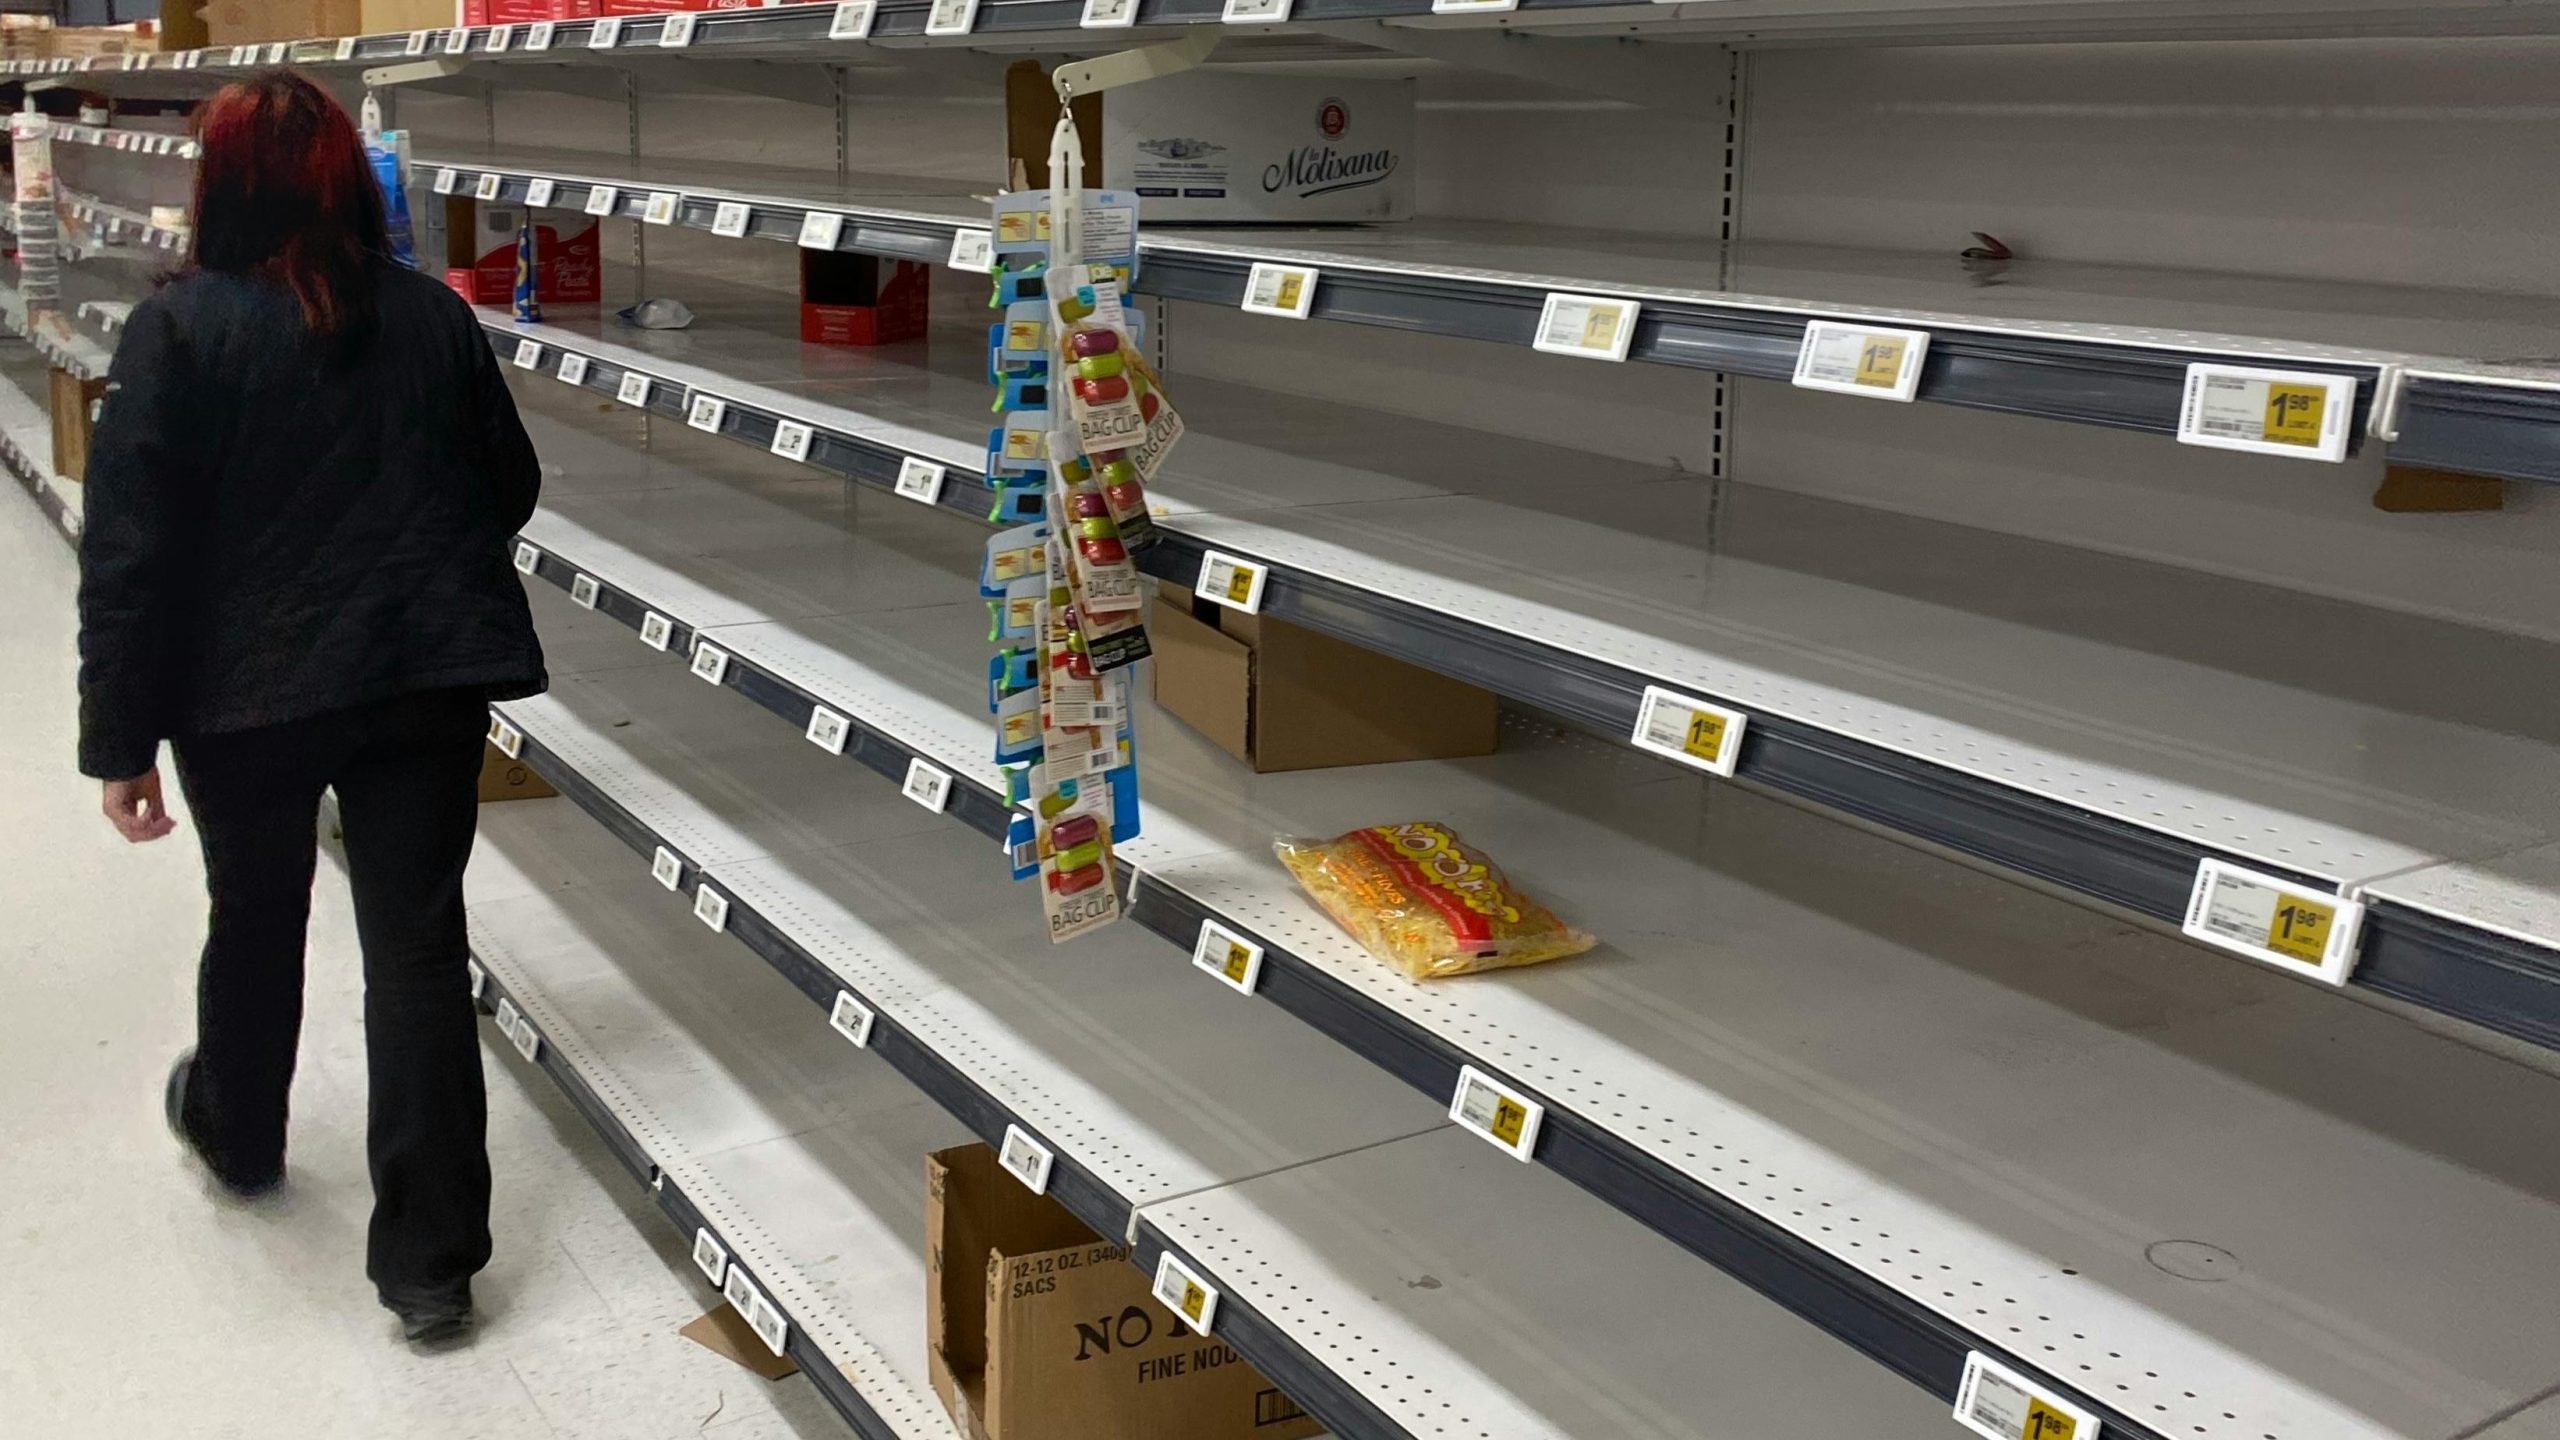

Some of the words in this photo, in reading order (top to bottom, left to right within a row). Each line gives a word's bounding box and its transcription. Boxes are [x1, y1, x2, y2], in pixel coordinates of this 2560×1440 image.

[1262, 145, 1397, 193] Molisana
[1081, 419, 1112, 440] BAG
[1112, 413, 1141, 434] CLIP
[1134, 438, 1160, 471] BAG
[1155, 411, 1176, 442] CLIP
[1086, 580, 1114, 598] BAG
[1051, 905, 1083, 932] BAG
[1085, 894, 1115, 918] CLIP
[1014, 1258, 1054, 1279] 12-12
[1058, 1252, 1083, 1270] OZ.
[1013, 1276, 1057, 1298] SACS
[1074, 1305, 1152, 1361] NO
[1138, 1353, 1187, 1383] FINE
